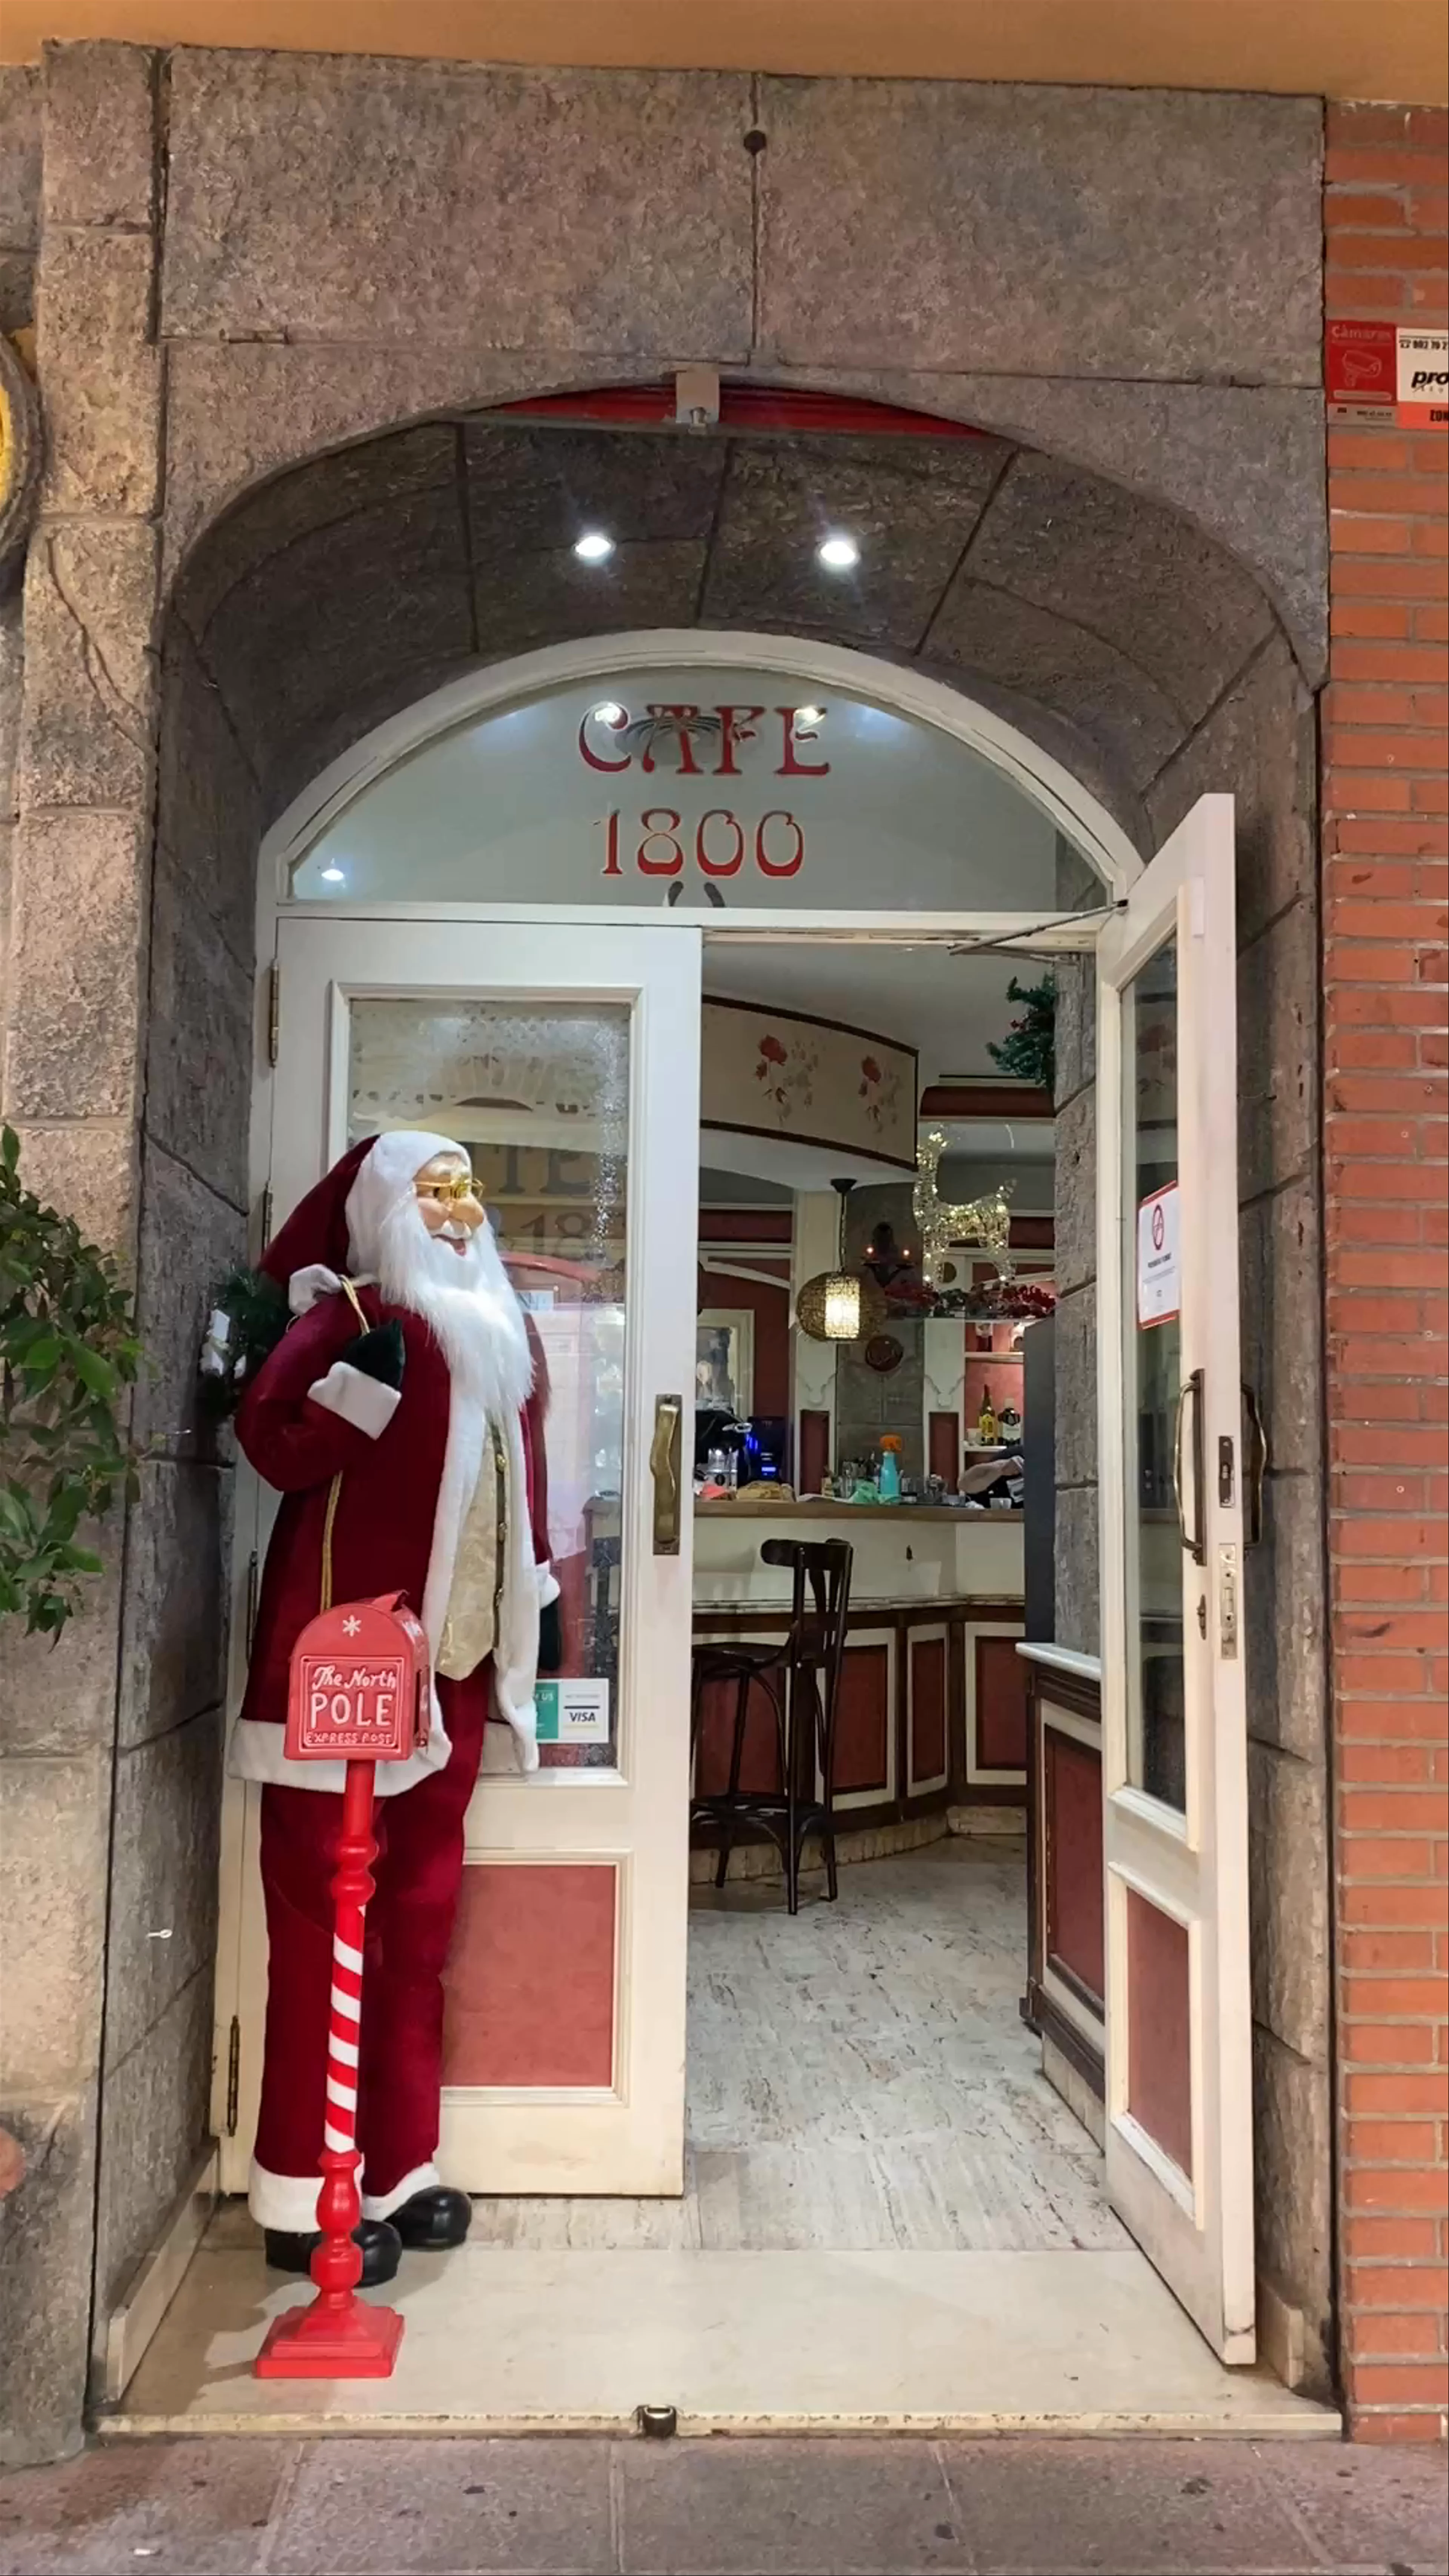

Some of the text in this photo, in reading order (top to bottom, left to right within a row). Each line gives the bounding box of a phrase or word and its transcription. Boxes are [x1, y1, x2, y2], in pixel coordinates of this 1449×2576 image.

[578, 701, 831, 775] CAFE
[601, 806, 805, 878] 1800
[312, 1664, 397, 1691] The North
[310, 1692, 394, 1729] POLE
[569, 1712, 596, 1722] VISA
[306, 1732, 392, 1744] EXPRESS POST
